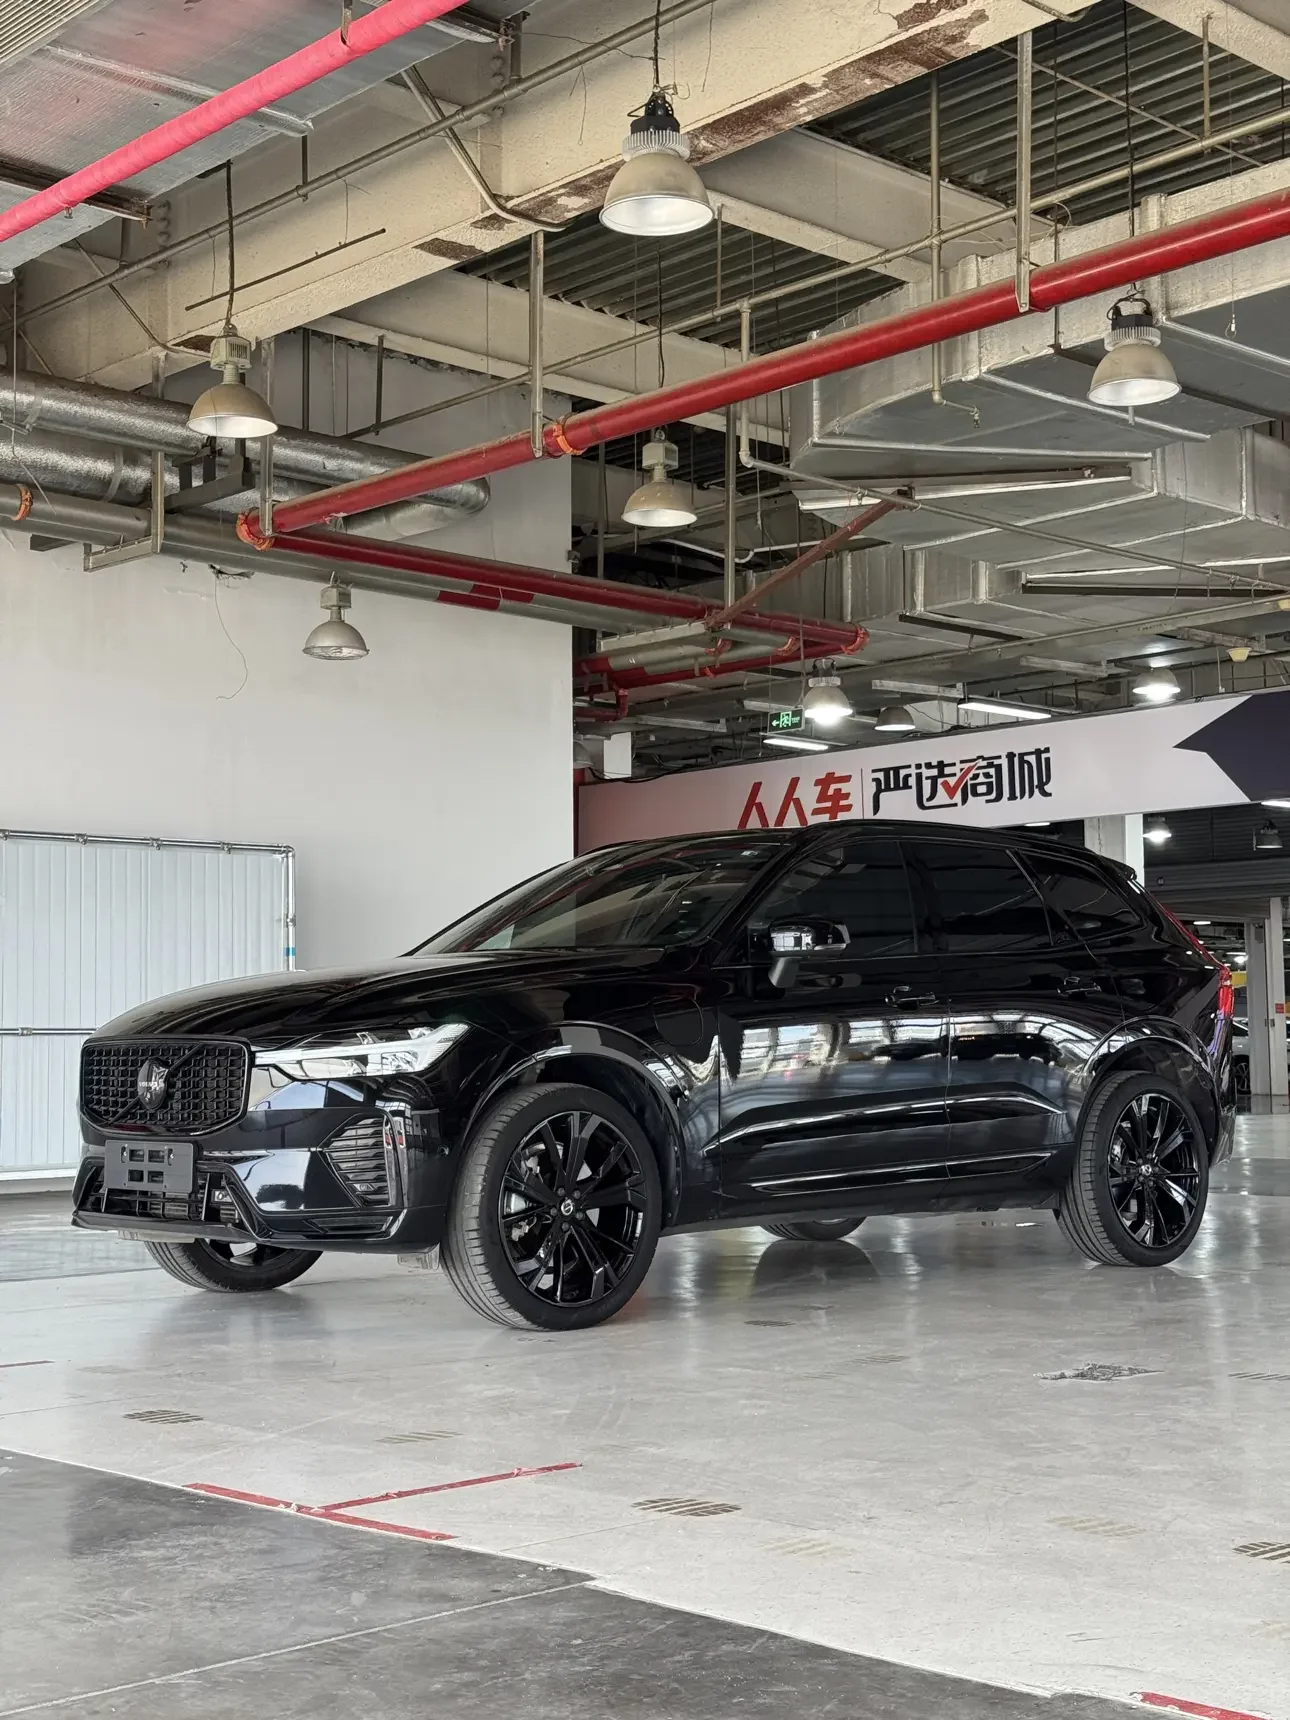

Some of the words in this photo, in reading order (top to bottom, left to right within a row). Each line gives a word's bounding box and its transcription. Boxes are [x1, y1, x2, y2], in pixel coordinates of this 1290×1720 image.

[737, 772, 853, 830] 人人车
[871, 746, 1053, 816] 严选商城
